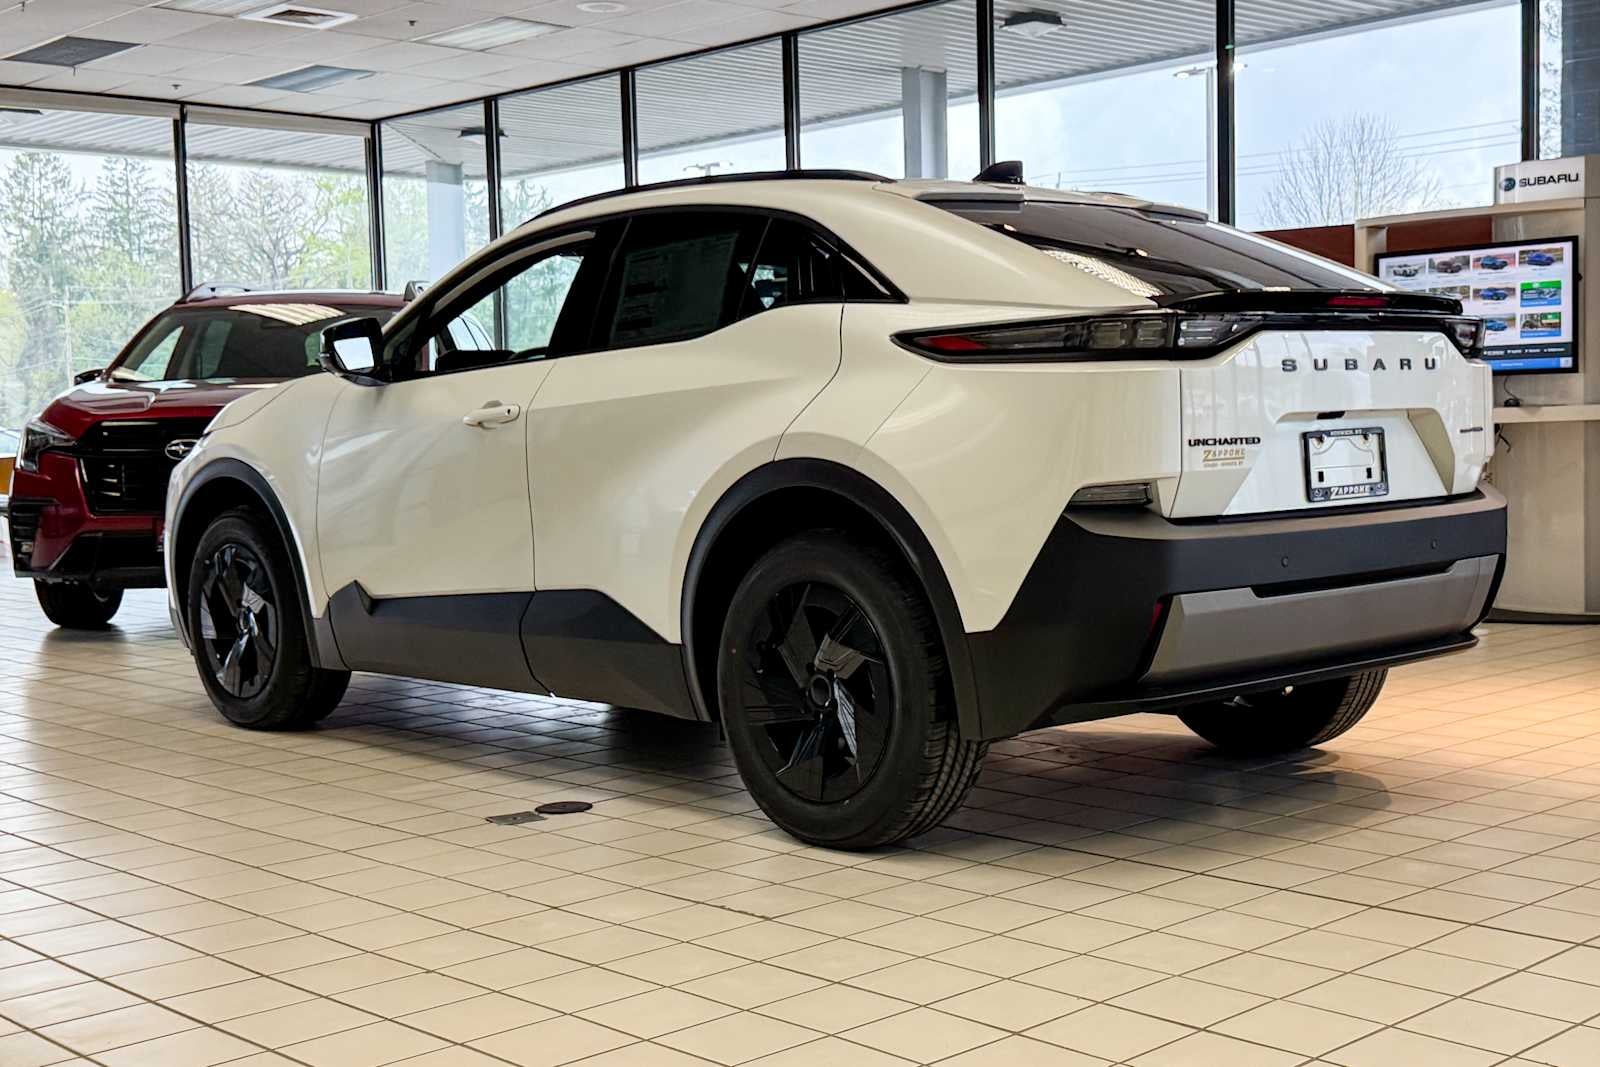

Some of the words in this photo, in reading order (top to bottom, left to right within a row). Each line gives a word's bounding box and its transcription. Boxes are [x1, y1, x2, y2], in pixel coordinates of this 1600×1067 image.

[1519, 173, 1579, 187] SUBARU
[1281, 357, 1436, 373] SUBARU
[1188, 437, 1261, 447] UNCHARTED
[1330, 485, 1371, 499] ZAPPONE
